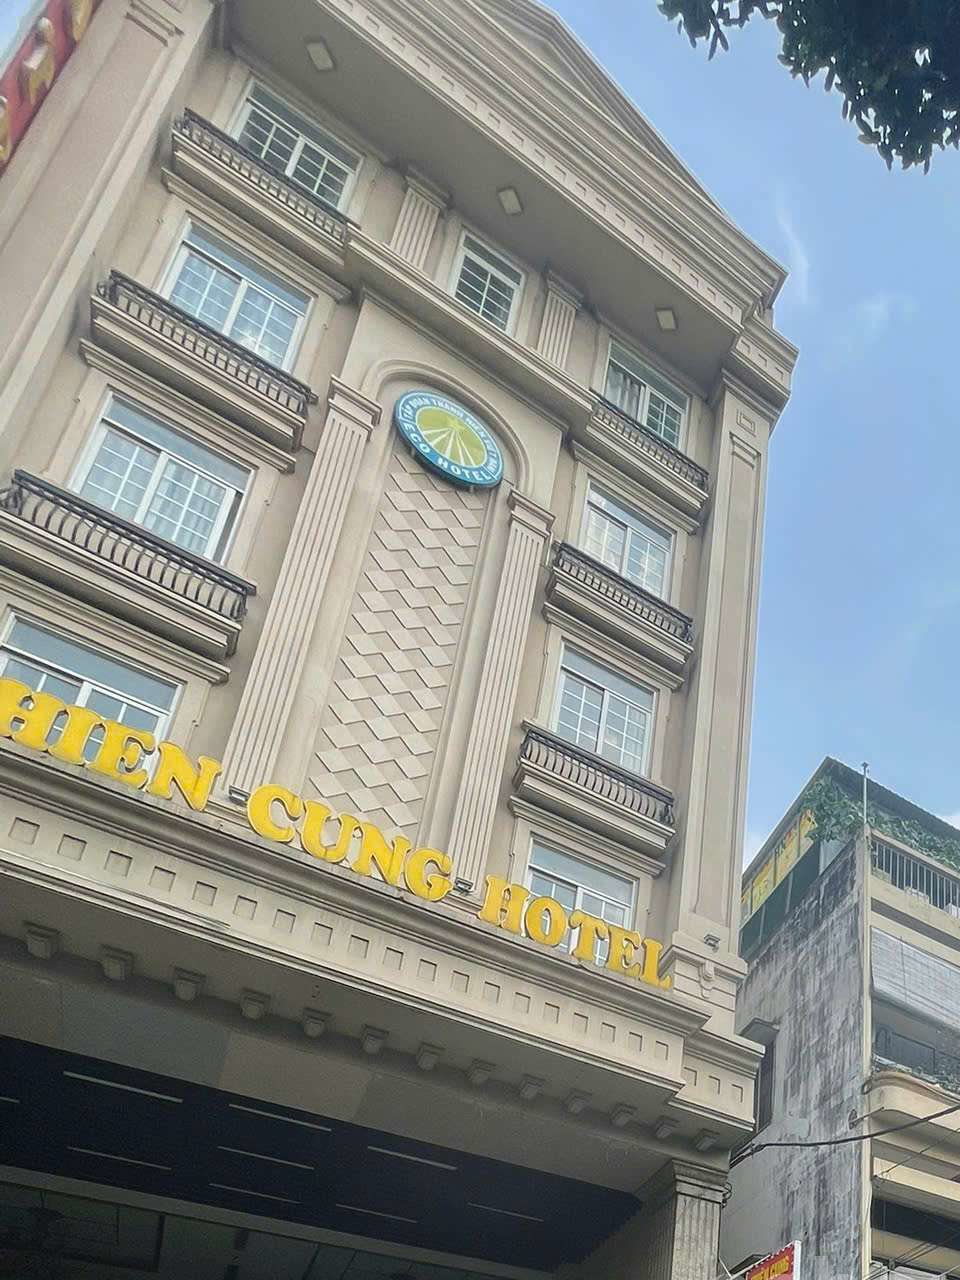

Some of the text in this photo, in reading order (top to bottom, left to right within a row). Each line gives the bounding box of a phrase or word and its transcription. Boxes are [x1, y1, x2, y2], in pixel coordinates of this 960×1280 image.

[402, 421, 492, 481] ECO HOTEL
[247, 783, 453, 903] CUNG
[476, 874, 673, 991] HOTEL
